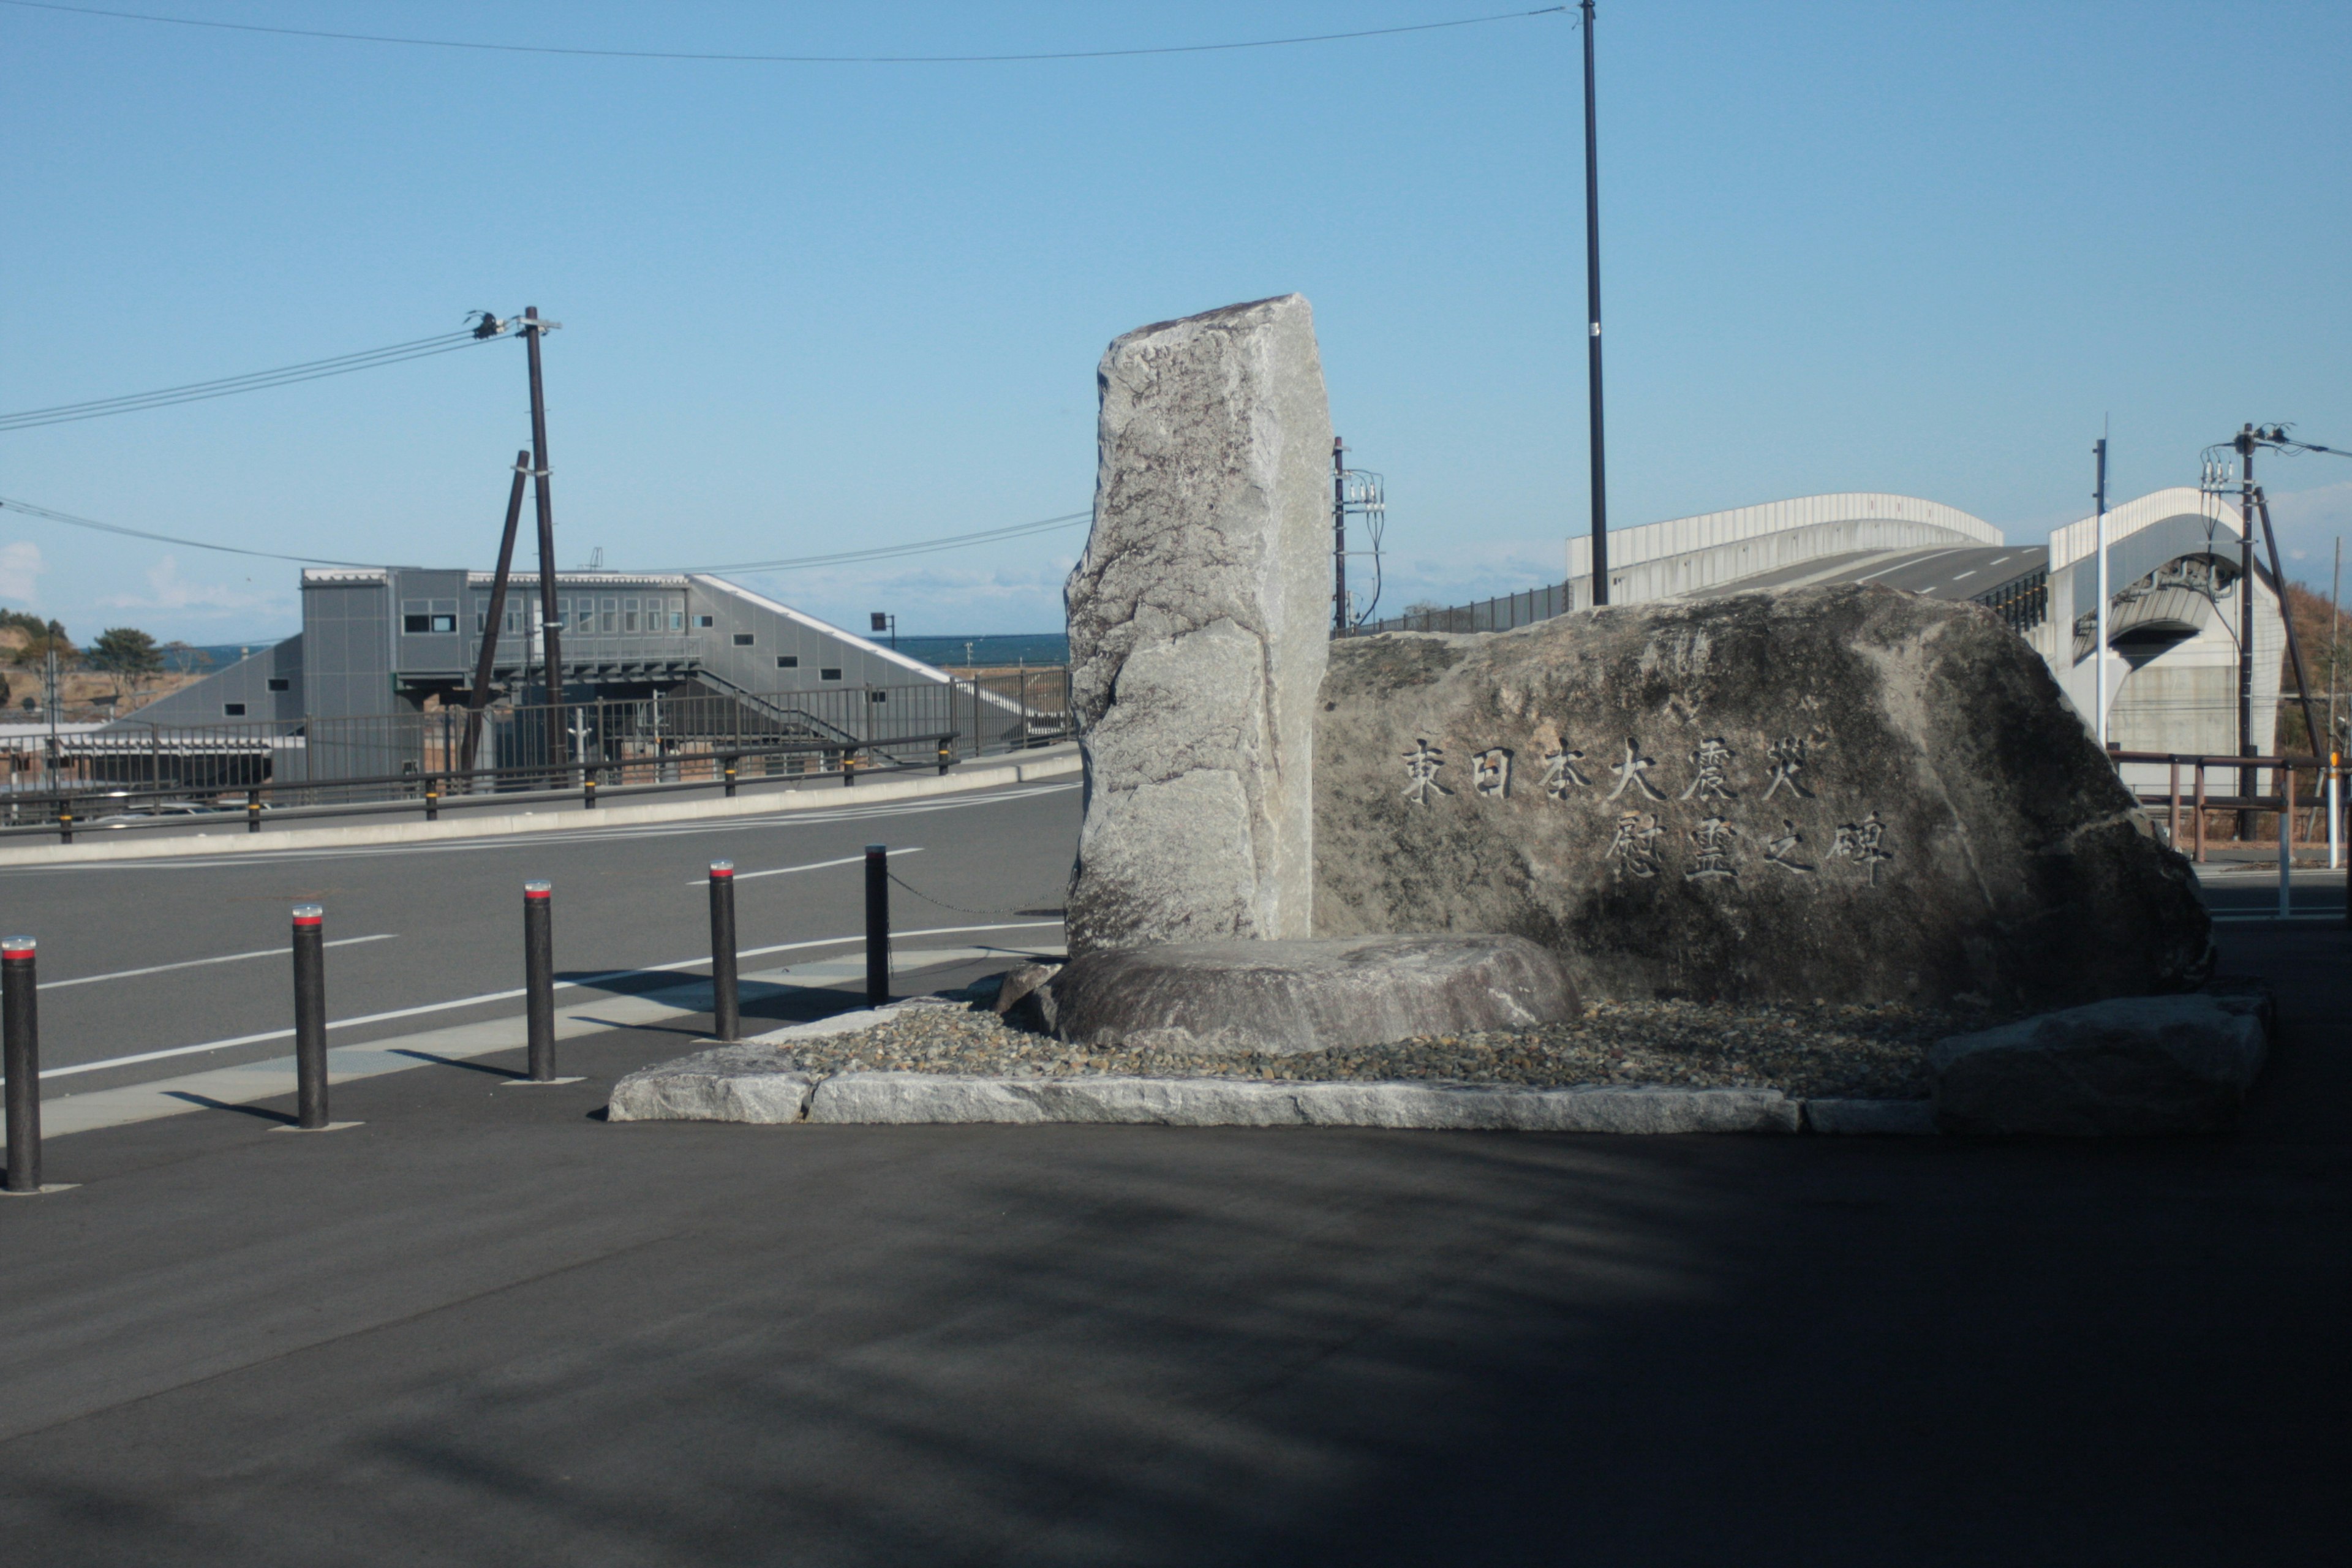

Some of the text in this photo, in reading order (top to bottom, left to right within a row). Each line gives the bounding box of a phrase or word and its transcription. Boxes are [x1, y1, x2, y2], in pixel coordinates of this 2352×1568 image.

[1401, 737, 1815, 805] 東日本大震災
[1605, 810, 1893, 888] 慰霊之碑
